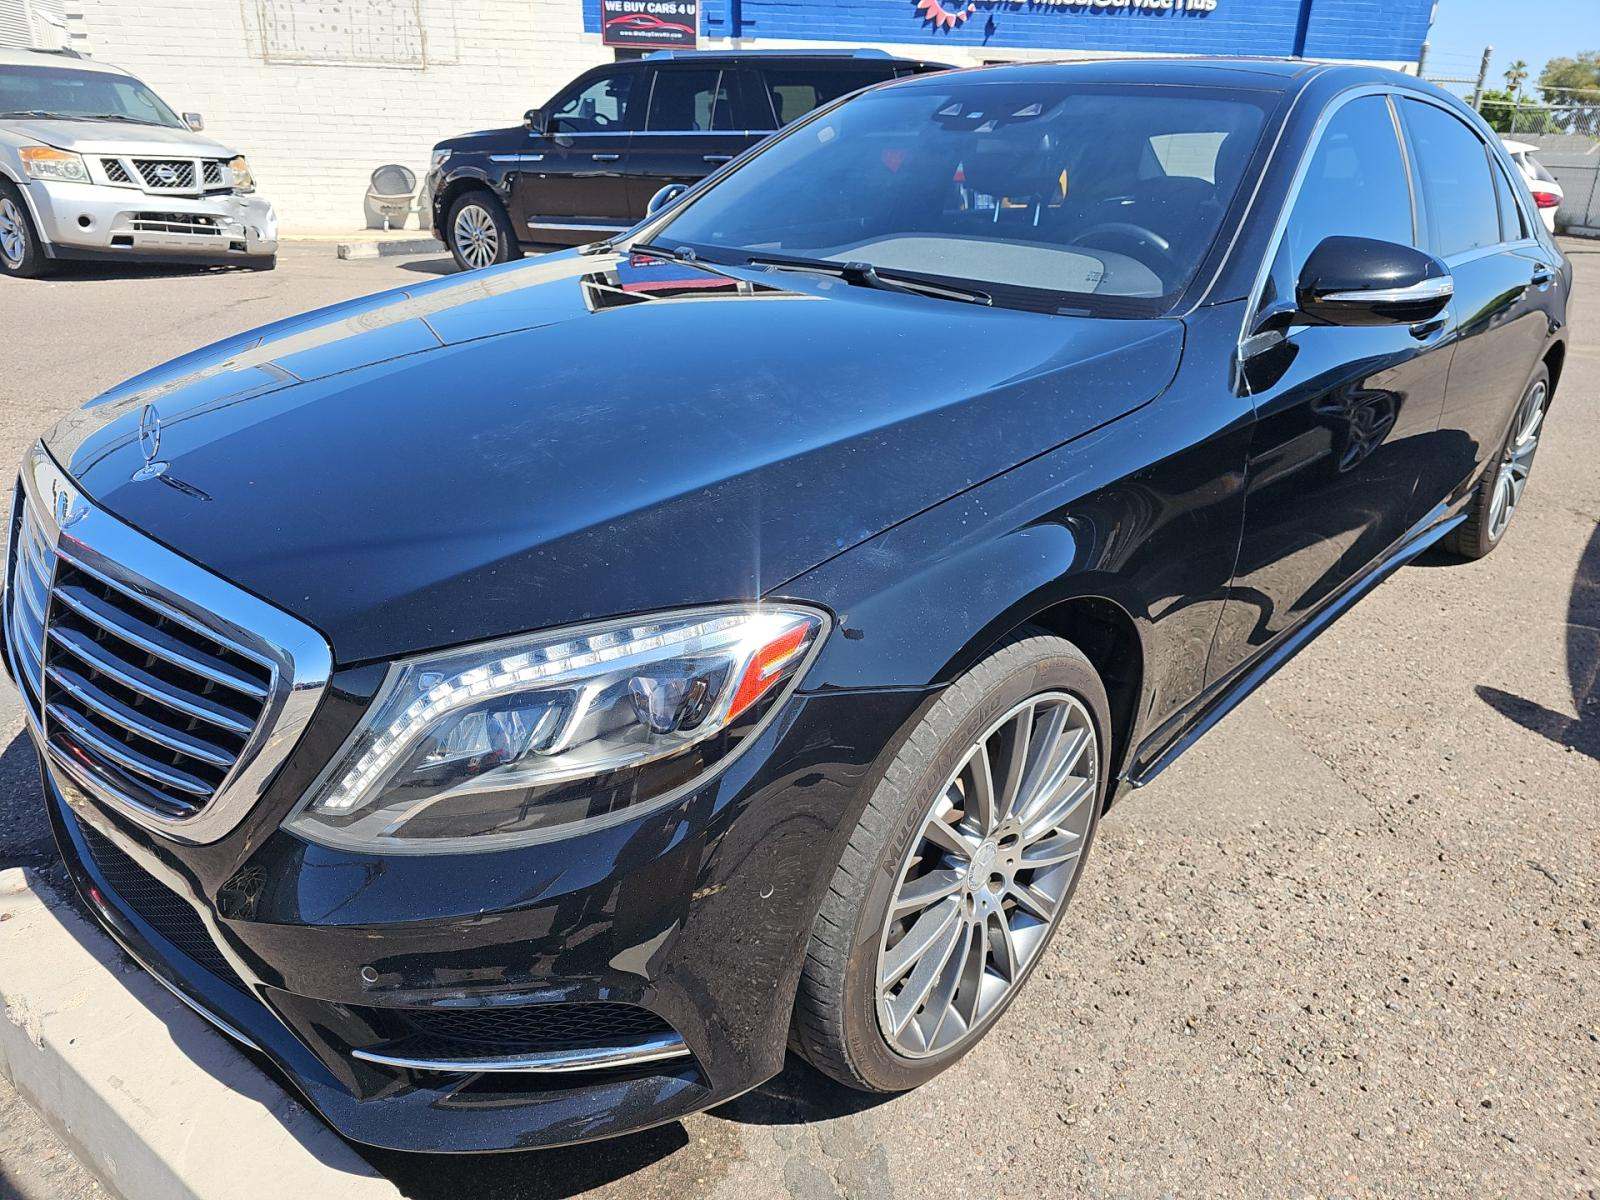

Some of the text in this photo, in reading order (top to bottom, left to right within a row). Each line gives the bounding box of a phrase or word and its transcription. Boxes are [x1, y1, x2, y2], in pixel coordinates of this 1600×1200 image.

[605, 1, 696, 15] WE BUY CARS 4 U
